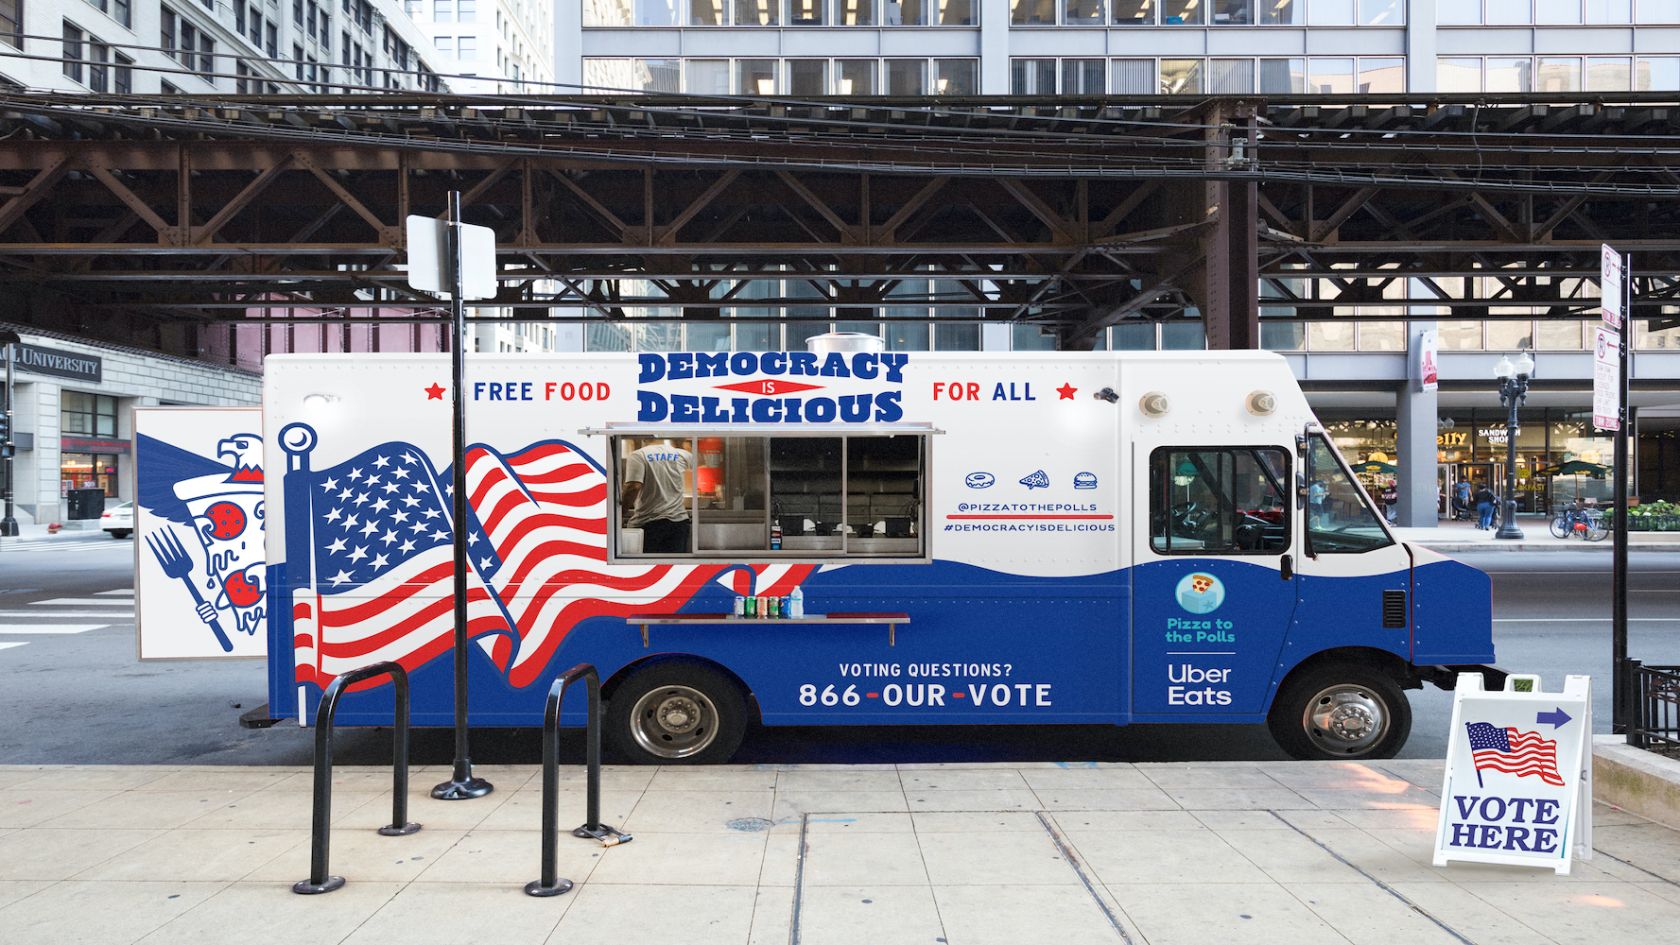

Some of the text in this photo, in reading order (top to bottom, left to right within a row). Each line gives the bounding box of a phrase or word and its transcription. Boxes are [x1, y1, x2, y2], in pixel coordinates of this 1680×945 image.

[21, 347, 98, 375] UNIVERSITY
[638, 351, 909, 384] DEMOCRACY
[474, 382, 611, 401] FREE FOOD
[761, 381, 775, 393] IS
[933, 382, 1036, 401] FOR ALL
[637, 390, 904, 423] DELICIOUS
[1436, 432, 1467, 445] elly
[647, 453, 679, 462] STAFF
[958, 503, 1097, 512] @PIZZATOTHEPOLLS
[944, 524, 1115, 532] #DEMOCRACYISDELICIOUS
[1167, 618, 1233, 629] Pizza to
[1165, 631, 1236, 642] the Polls
[839, 663, 1013, 678] VOTING QUESTIONS?
[1168, 664, 1231, 683] Uber
[1168, 686, 1232, 705] Eats
[1453, 795, 1560, 824] VOTE
[1450, 823, 1558, 853] HERE
